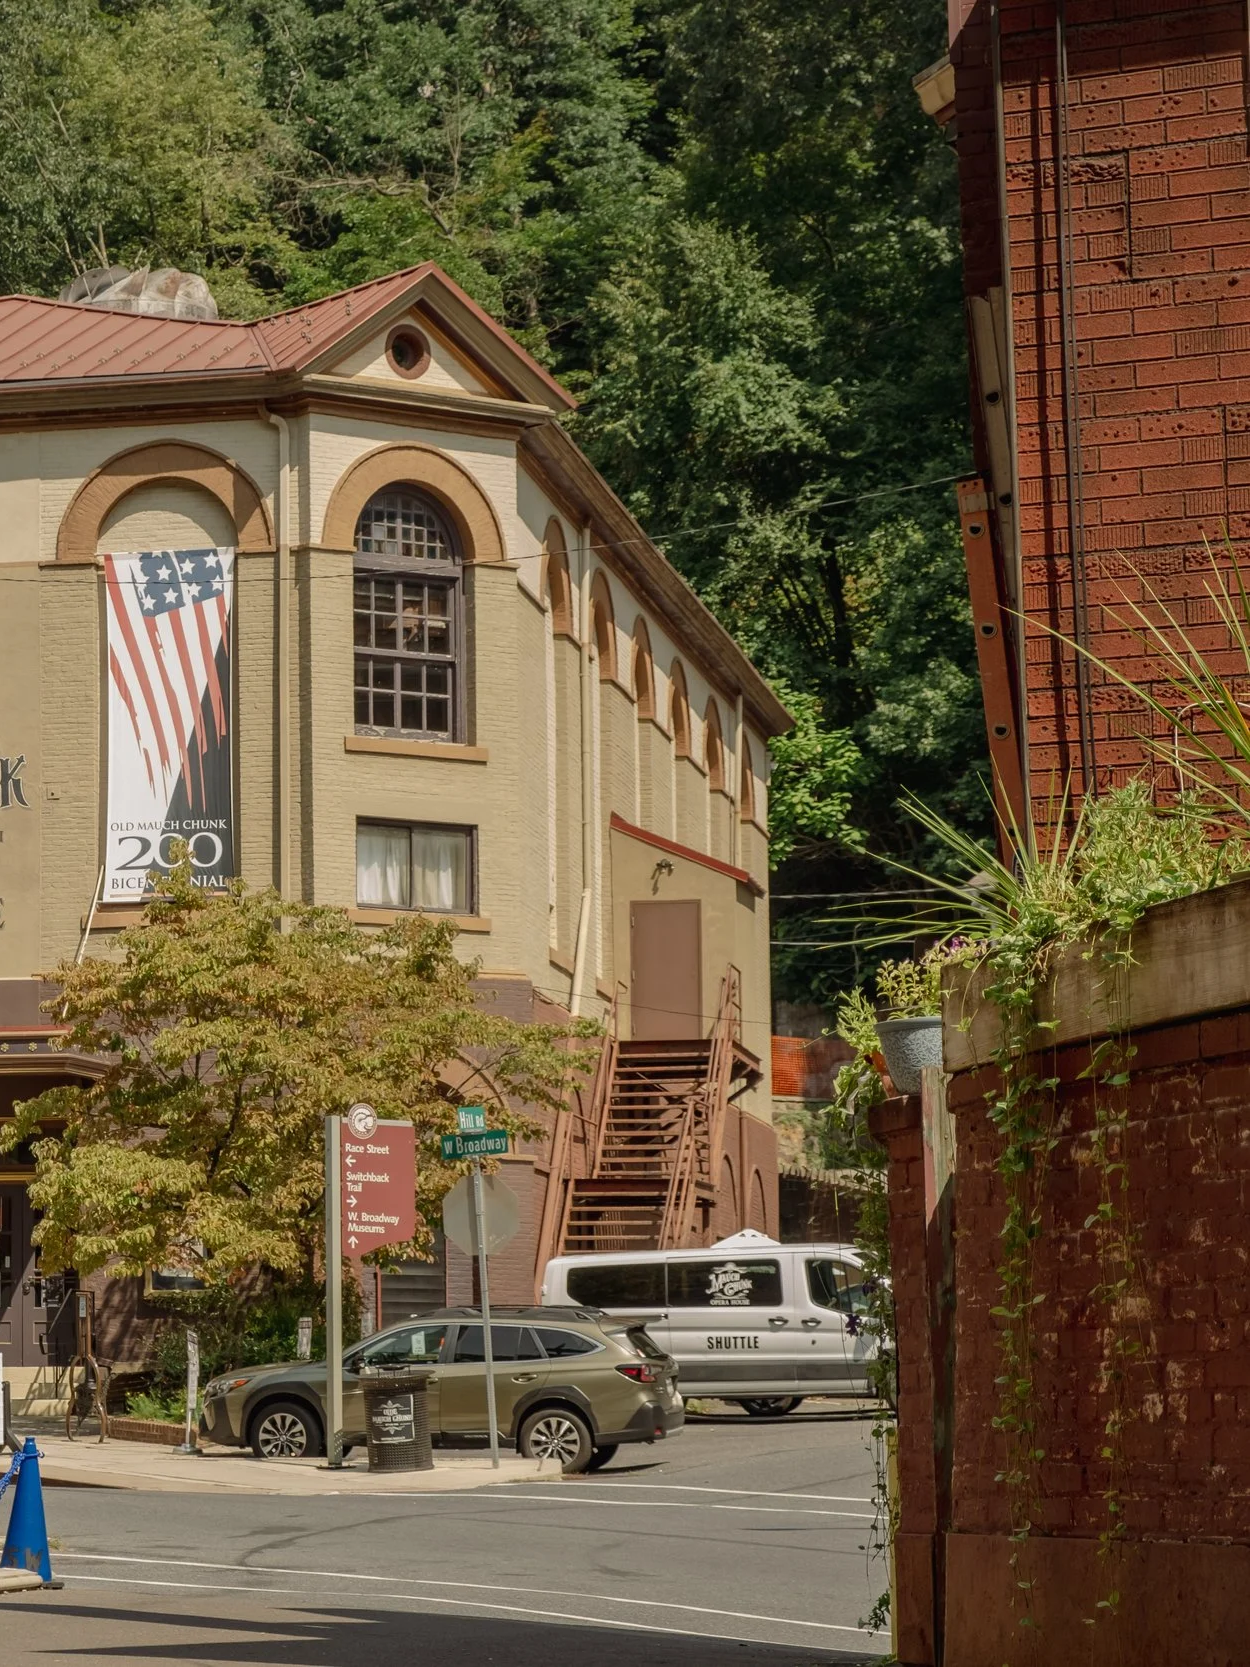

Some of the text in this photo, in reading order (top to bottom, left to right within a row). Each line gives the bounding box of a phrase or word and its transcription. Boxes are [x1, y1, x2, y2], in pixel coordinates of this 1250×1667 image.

[110, 819, 227, 831] OLD MAUCH CHUNK
[114, 832, 223, 871] 200
[459, 1111, 474, 1129] Hill
[345, 1143, 390, 1154] Race Street
[456, 1136, 507, 1153] Broadway
[346, 1171, 390, 1183] Switchback
[347, 1183, 362, 1192] Trail
[348, 1212, 400, 1226] W. Broadway
[347, 1223, 385, 1234] Museums
[705, 1272, 740, 1294] MAUCH
[724, 1279, 753, 1297] CHUNK
[707, 1336, 759, 1349] SHUTTLE
